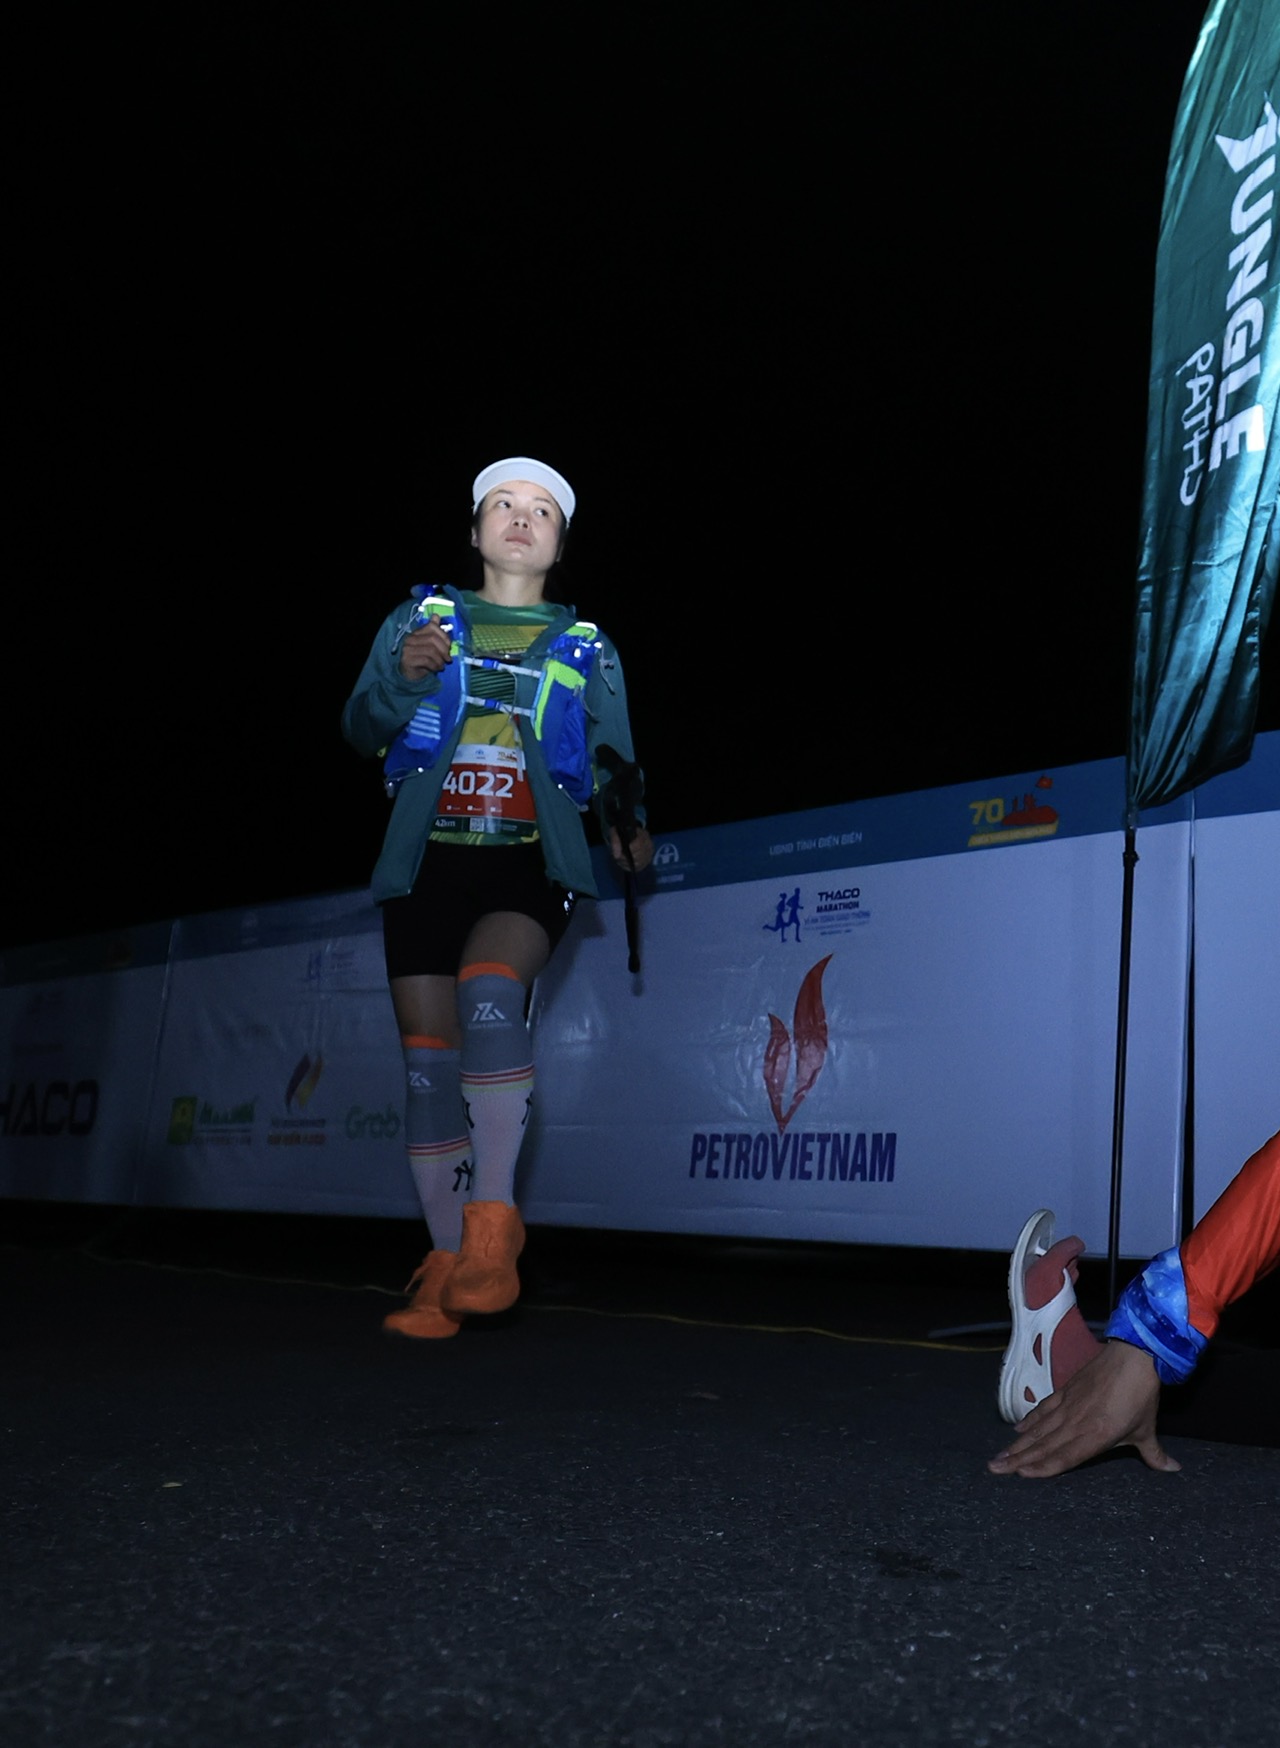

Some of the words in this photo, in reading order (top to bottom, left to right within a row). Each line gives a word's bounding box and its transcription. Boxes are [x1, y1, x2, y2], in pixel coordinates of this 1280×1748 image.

[442, 769, 515, 799] 4022
[970, 797, 1005, 826] 70
[816, 901, 860, 914] MARATHON
[818, 887, 860, 901] THACO
[345, 1104, 399, 1140] Grab
[689, 1132, 897, 1183] PETROVIETNAM
